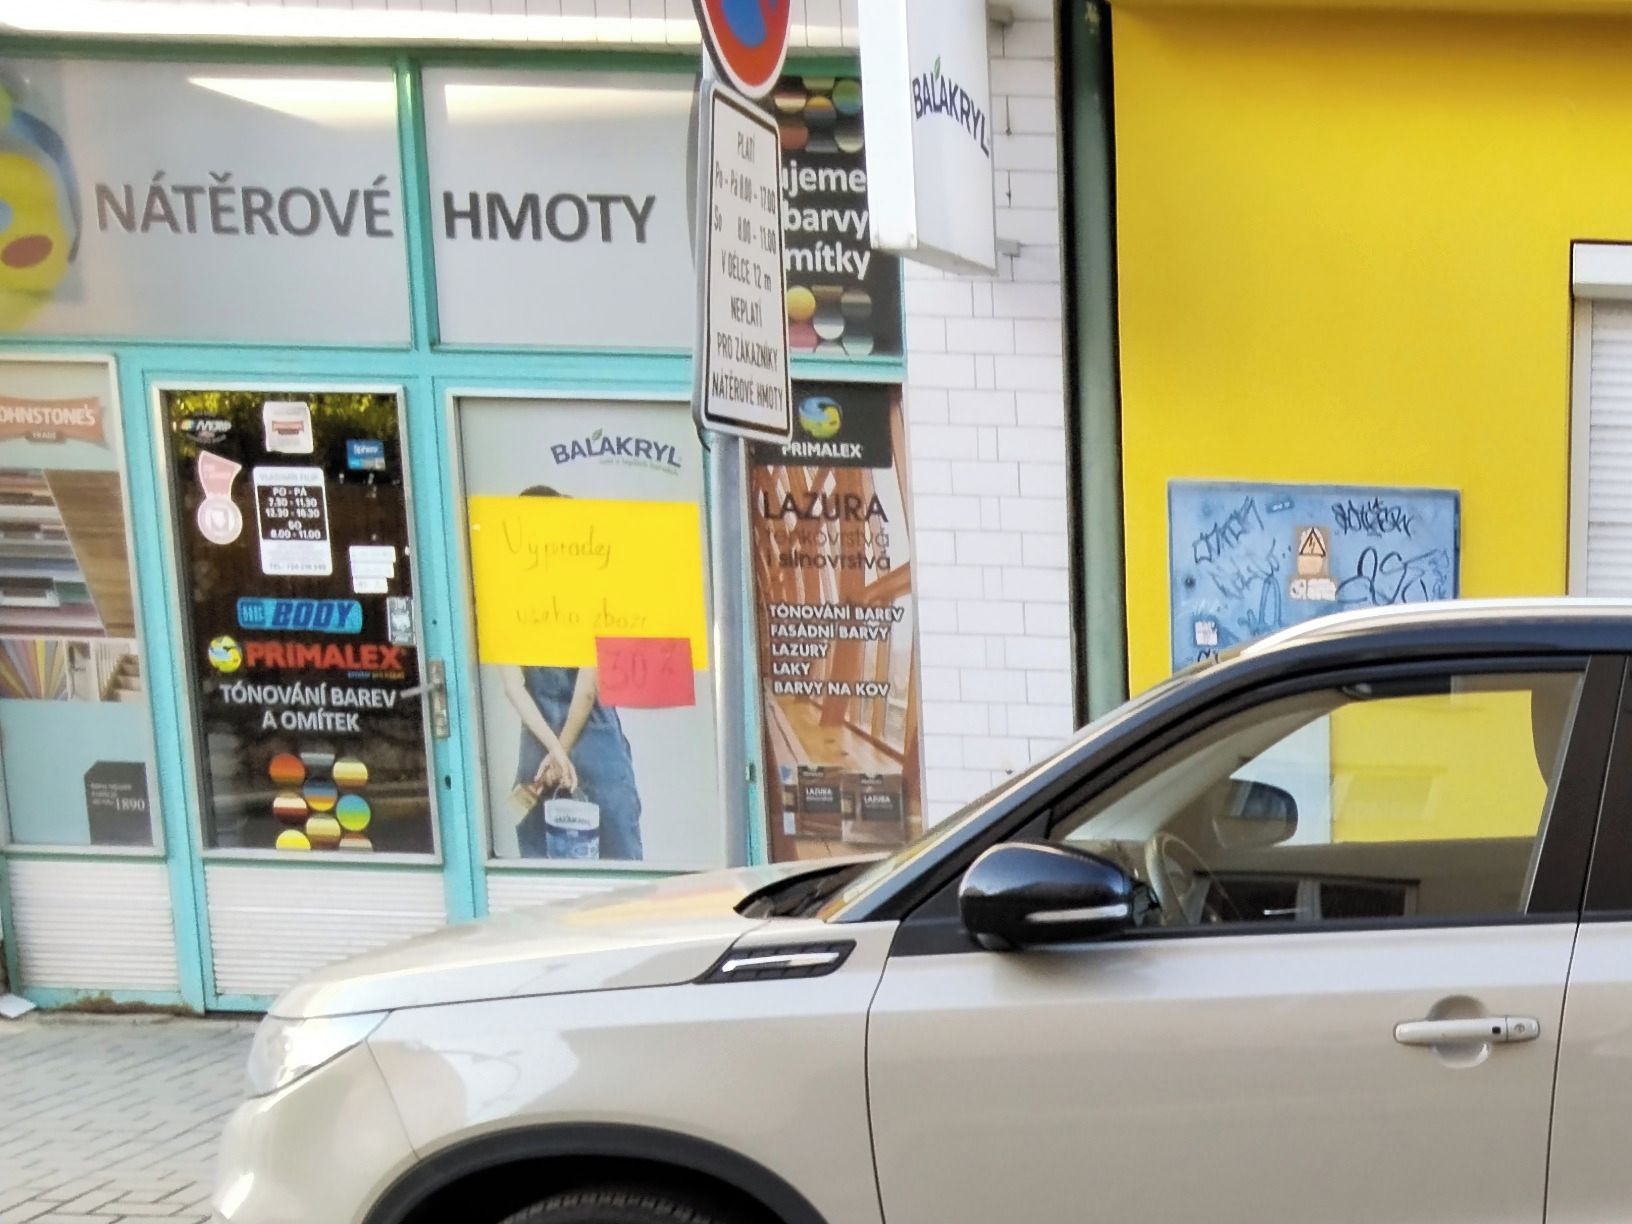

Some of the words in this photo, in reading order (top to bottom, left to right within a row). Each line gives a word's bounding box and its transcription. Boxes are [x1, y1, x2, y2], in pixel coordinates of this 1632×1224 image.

[737, 130, 755, 164] PLATÍ
[715, 160, 723, 189] Po
[760, 185, 776, 215] 17.00
[94, 169, 394, 239] NÁTĚROVÉ
[441, 190, 657, 244] HMOTY
[782, 198, 868, 240] barvy
[714, 204, 722, 232] So
[738, 216, 751, 244] 8.00
[760, 226, 776, 255] 11.00
[721, 248, 728, 275] V
[728, 249, 750, 286] DÉLCE
[753, 262, 762, 290] 12
[730, 295, 763, 329] NEPLATÍ
[716, 331, 733, 361] PRO
[735, 332, 778, 373] ZÁKAZNÍKY
[756, 382, 783, 411] HMOTY
[550, 436, 682, 466] BALAKRYL
[782, 441, 862, 459] PRIMALEX
[272, 486, 287, 497] PO
[763, 491, 889, 523] LAZURA
[299, 529, 321, 539] 11.00
[271, 602, 356, 628] BODY
[769, 602, 850, 621] TÓNOVÁNÍ
[855, 607, 905, 622] BAREV
[770, 622, 834, 639] FASÁDNÍ
[839, 625, 890, 640] BARVY
[244, 640, 401, 670] PRIMALEX
[772, 642, 830, 658] LAZURY
[772, 661, 811, 676] LAKY
[219, 679, 327, 706] TÓNOVÁNÍ
[331, 688, 397, 709] BAREV
[773, 681, 824, 695] BARVY
[827, 682, 851, 696] NA
[855, 682, 890, 697] KOV
[262, 710, 278, 730] A
[281, 707, 361, 732] OMÍTEK
